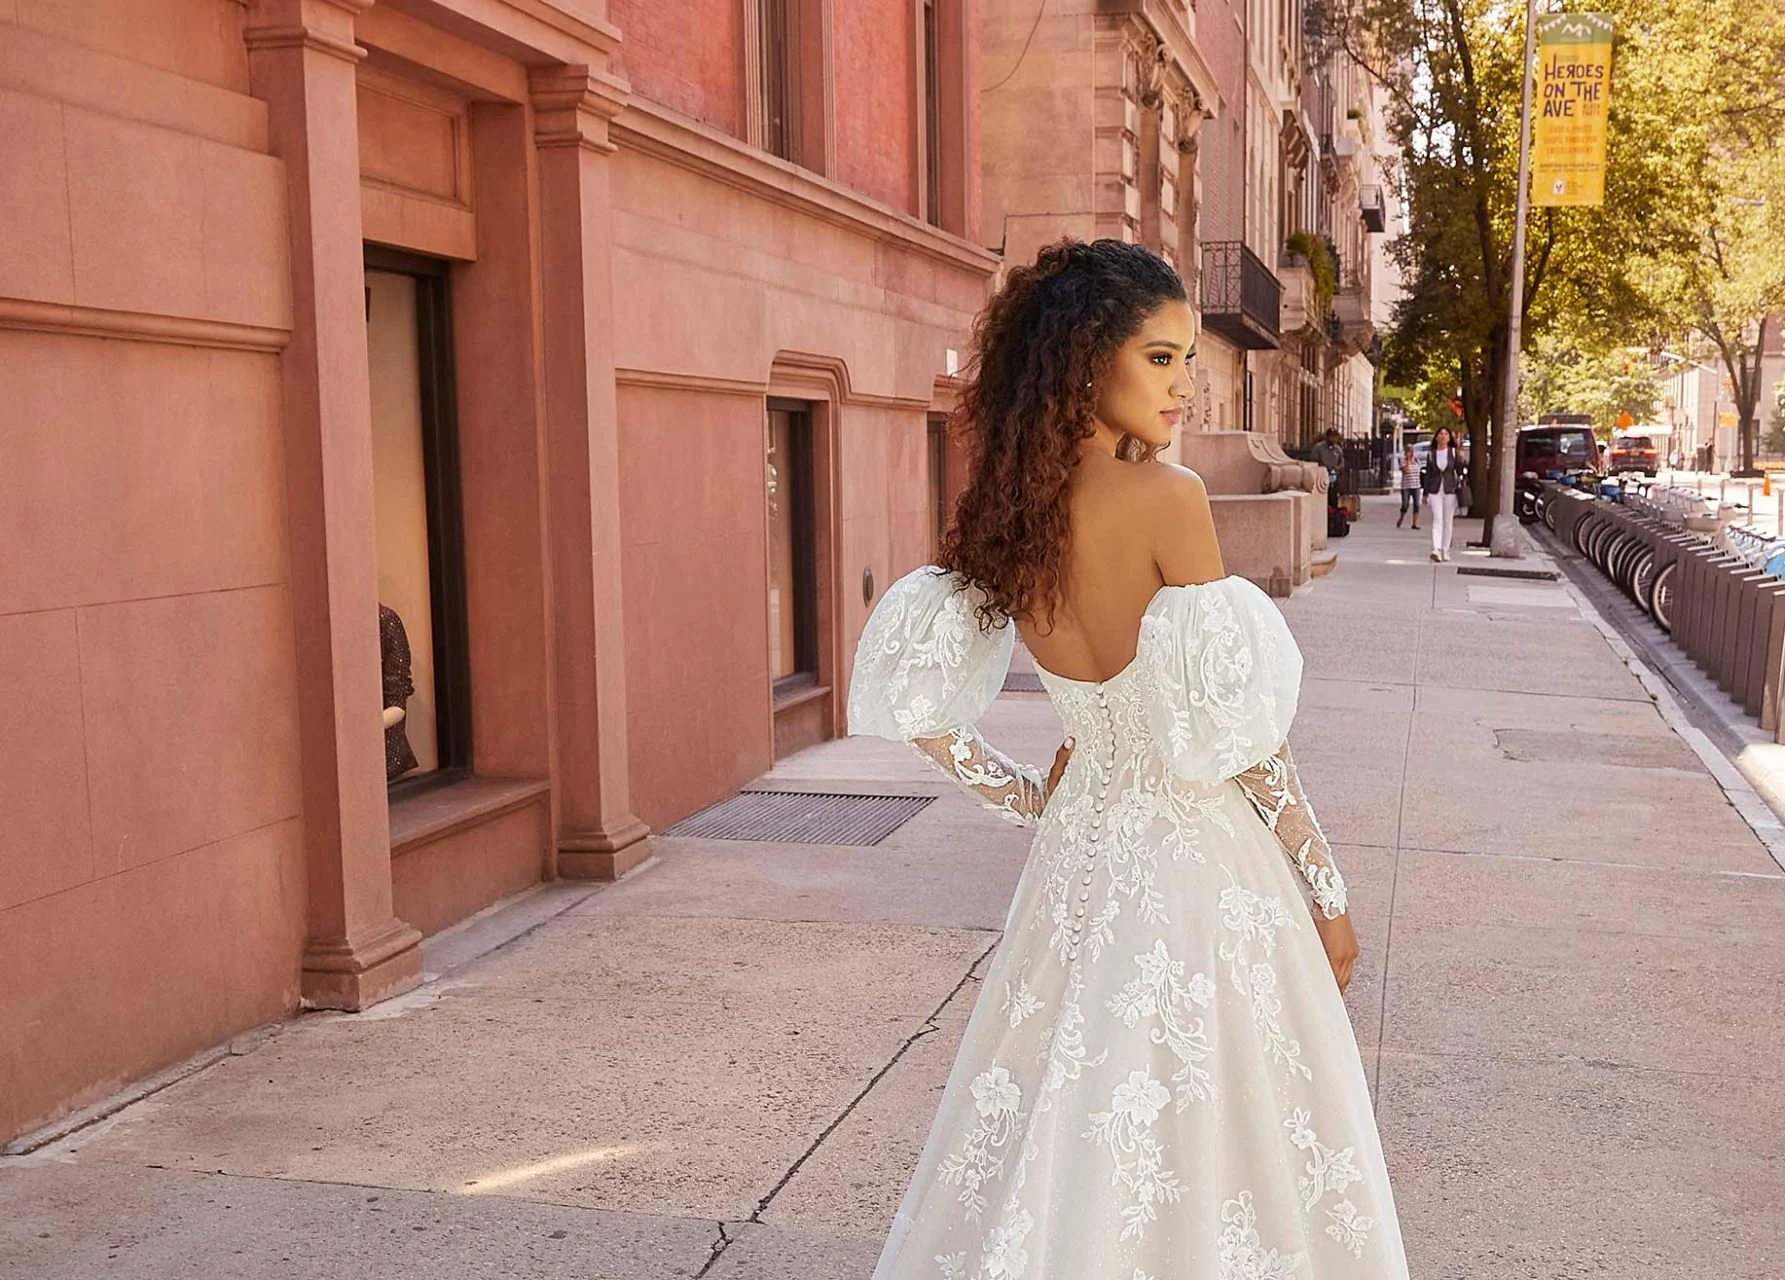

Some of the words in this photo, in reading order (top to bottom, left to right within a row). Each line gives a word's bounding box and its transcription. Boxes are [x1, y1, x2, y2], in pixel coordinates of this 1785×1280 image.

[1544, 54, 1604, 81] HEROES
[1544, 82, 1565, 98] ON
[1570, 82, 1602, 101] THE
[1543, 100, 1576, 117] AVE
